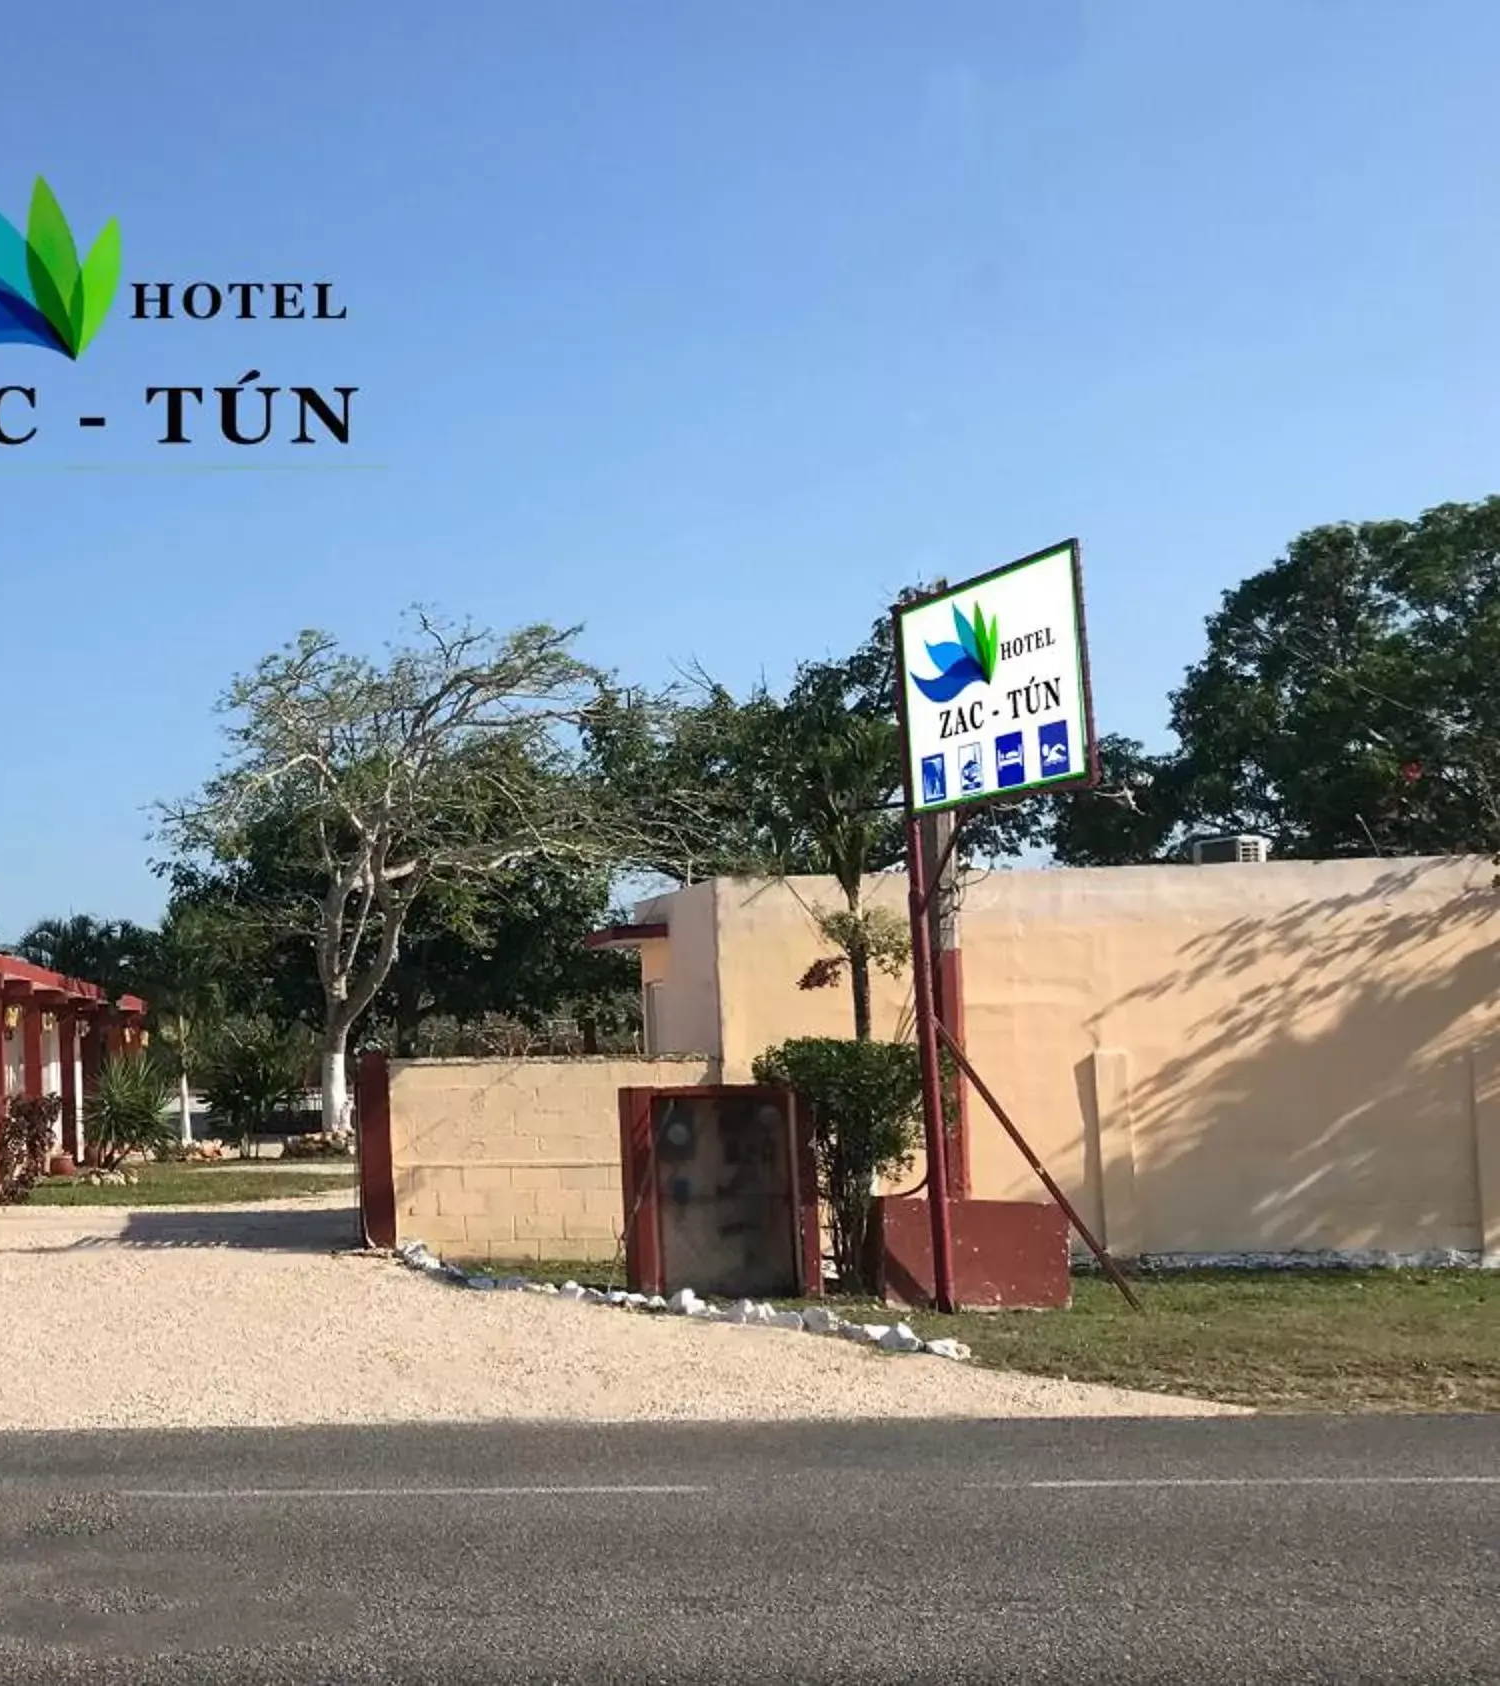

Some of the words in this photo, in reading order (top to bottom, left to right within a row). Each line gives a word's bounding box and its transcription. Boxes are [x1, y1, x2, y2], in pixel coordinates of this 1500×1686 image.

[1000, 627, 1056, 661] HOTEL
[939, 700, 985, 739] ZAC
[1007, 676, 1062, 720] TÚN
